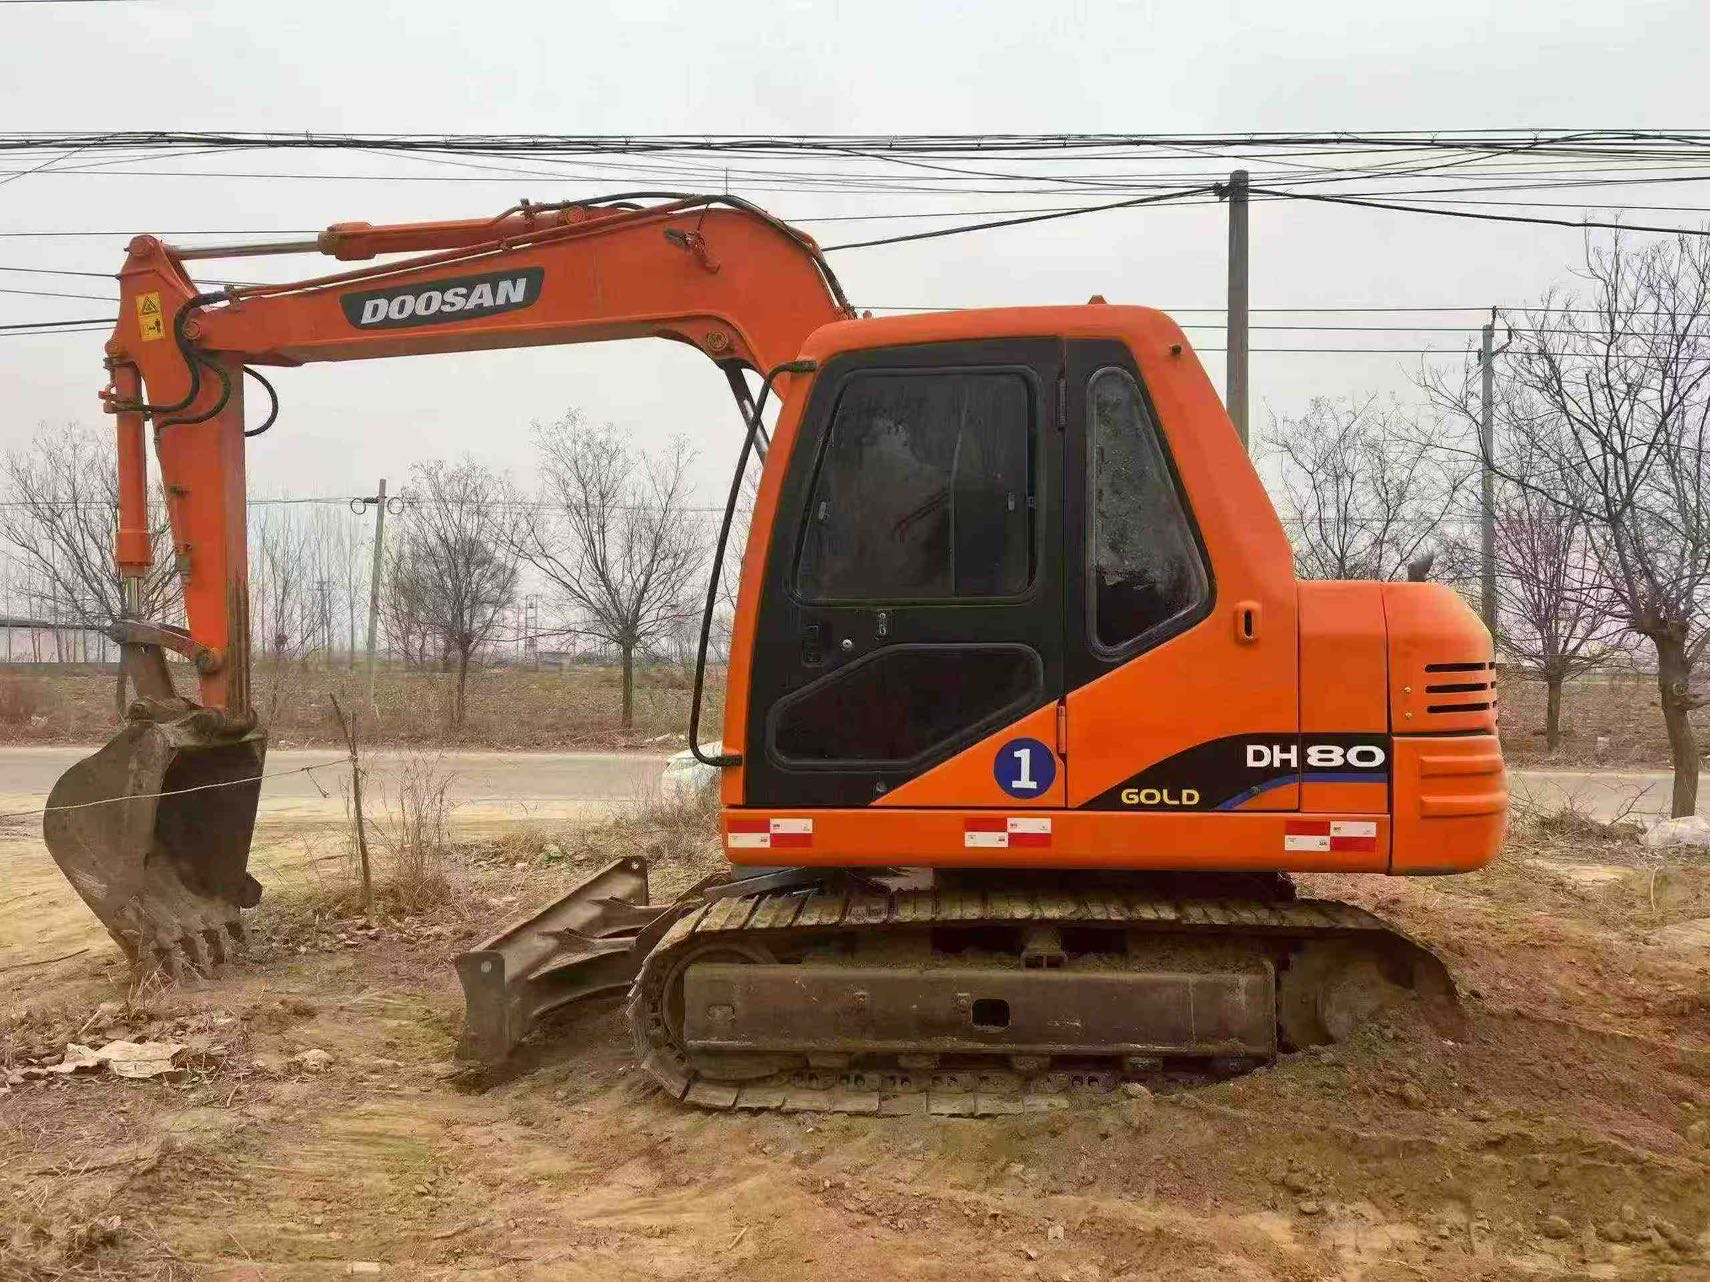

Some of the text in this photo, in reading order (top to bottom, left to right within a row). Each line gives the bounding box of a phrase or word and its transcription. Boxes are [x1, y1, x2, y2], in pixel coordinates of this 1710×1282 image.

[361, 278, 526, 324] DOOSAN
[1012, 748, 1037, 789] 1
[1121, 788, 1200, 805] GOLD
